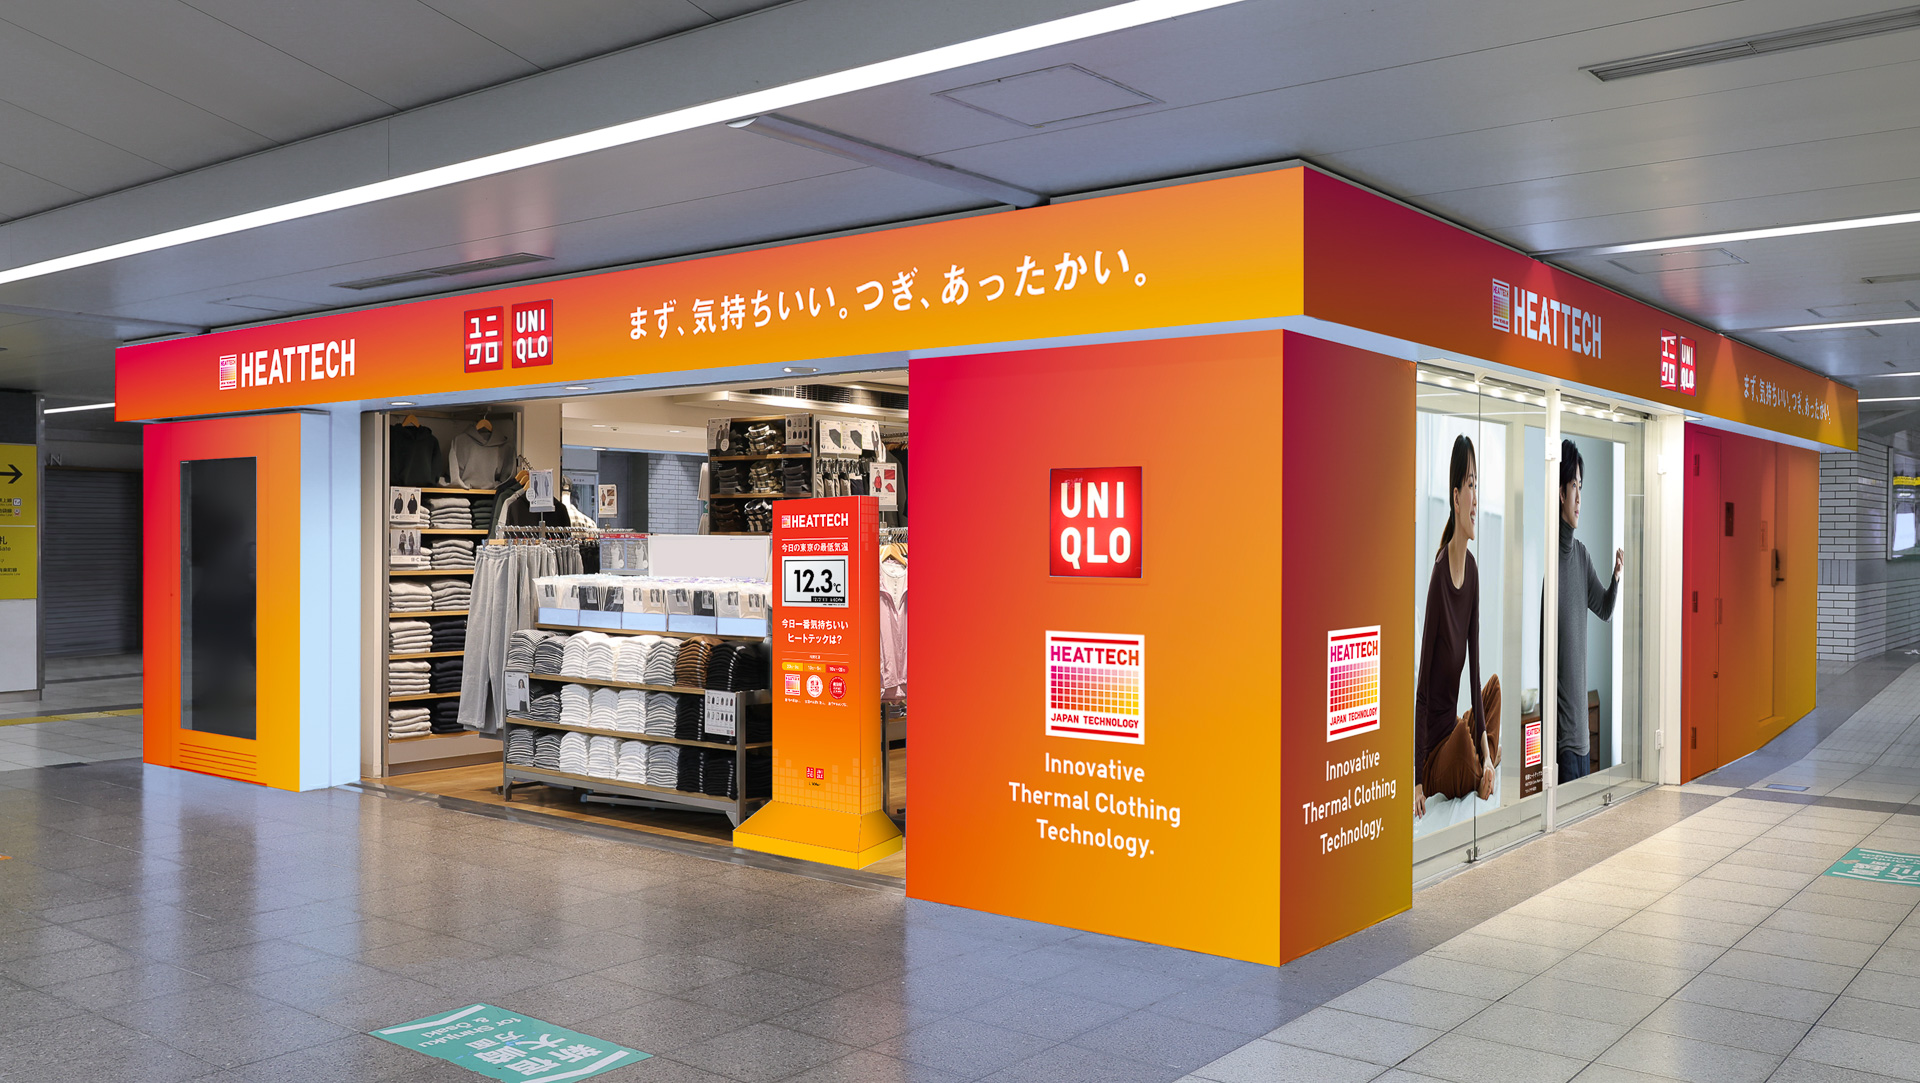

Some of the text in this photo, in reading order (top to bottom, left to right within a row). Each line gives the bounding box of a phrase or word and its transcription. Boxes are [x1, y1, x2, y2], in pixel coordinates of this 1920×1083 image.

[628, 248, 1148, 341] まず、気持ちいい。つぎ、あったかい。
[469, 315, 498, 339] ユニ
[516, 308, 545, 333] UNI
[1514, 286, 1602, 359] HEATTECH
[241, 338, 356, 388] HEATTECH
[468, 341, 498, 365] クロ
[516, 335, 548, 364] QLO
[1681, 343, 1694, 366] UNI
[1680, 367, 1695, 391] QLO
[1061, 481, 1125, 518] UNI
[791, 513, 849, 528] HEATTECH
[781, 542, 849, 552] 今日の東京の最低気温
[1061, 526, 1131, 570] QLO
[781, 618, 849, 630] 今日一番気持ちいい
[1050, 645, 1139, 666] HEATTECH
[1330, 640, 1378, 663] HEATTECH
[1051, 713, 1139, 729] JAPAN TECHNOLOGY
[1330, 707, 1378, 726] JAPAN TECHNOLOGY
[1045, 752, 1145, 783] Innovative
[1325, 750, 1380, 782] Innovative
[1008, 781, 1181, 828] Thermal Clothing
[1303, 778, 1397, 825] Thermal Clothing
[1036, 818, 1154, 859] Technology.
[1320, 817, 1384, 855] Technology.
[418, 1017, 522, 1048] for Shinjuku
[472, 1016, 490, 1024] &
[465, 1031, 526, 1050] 方面
[473, 1033, 567, 1065] 大崎
[504, 1044, 603, 1075] 新宿
